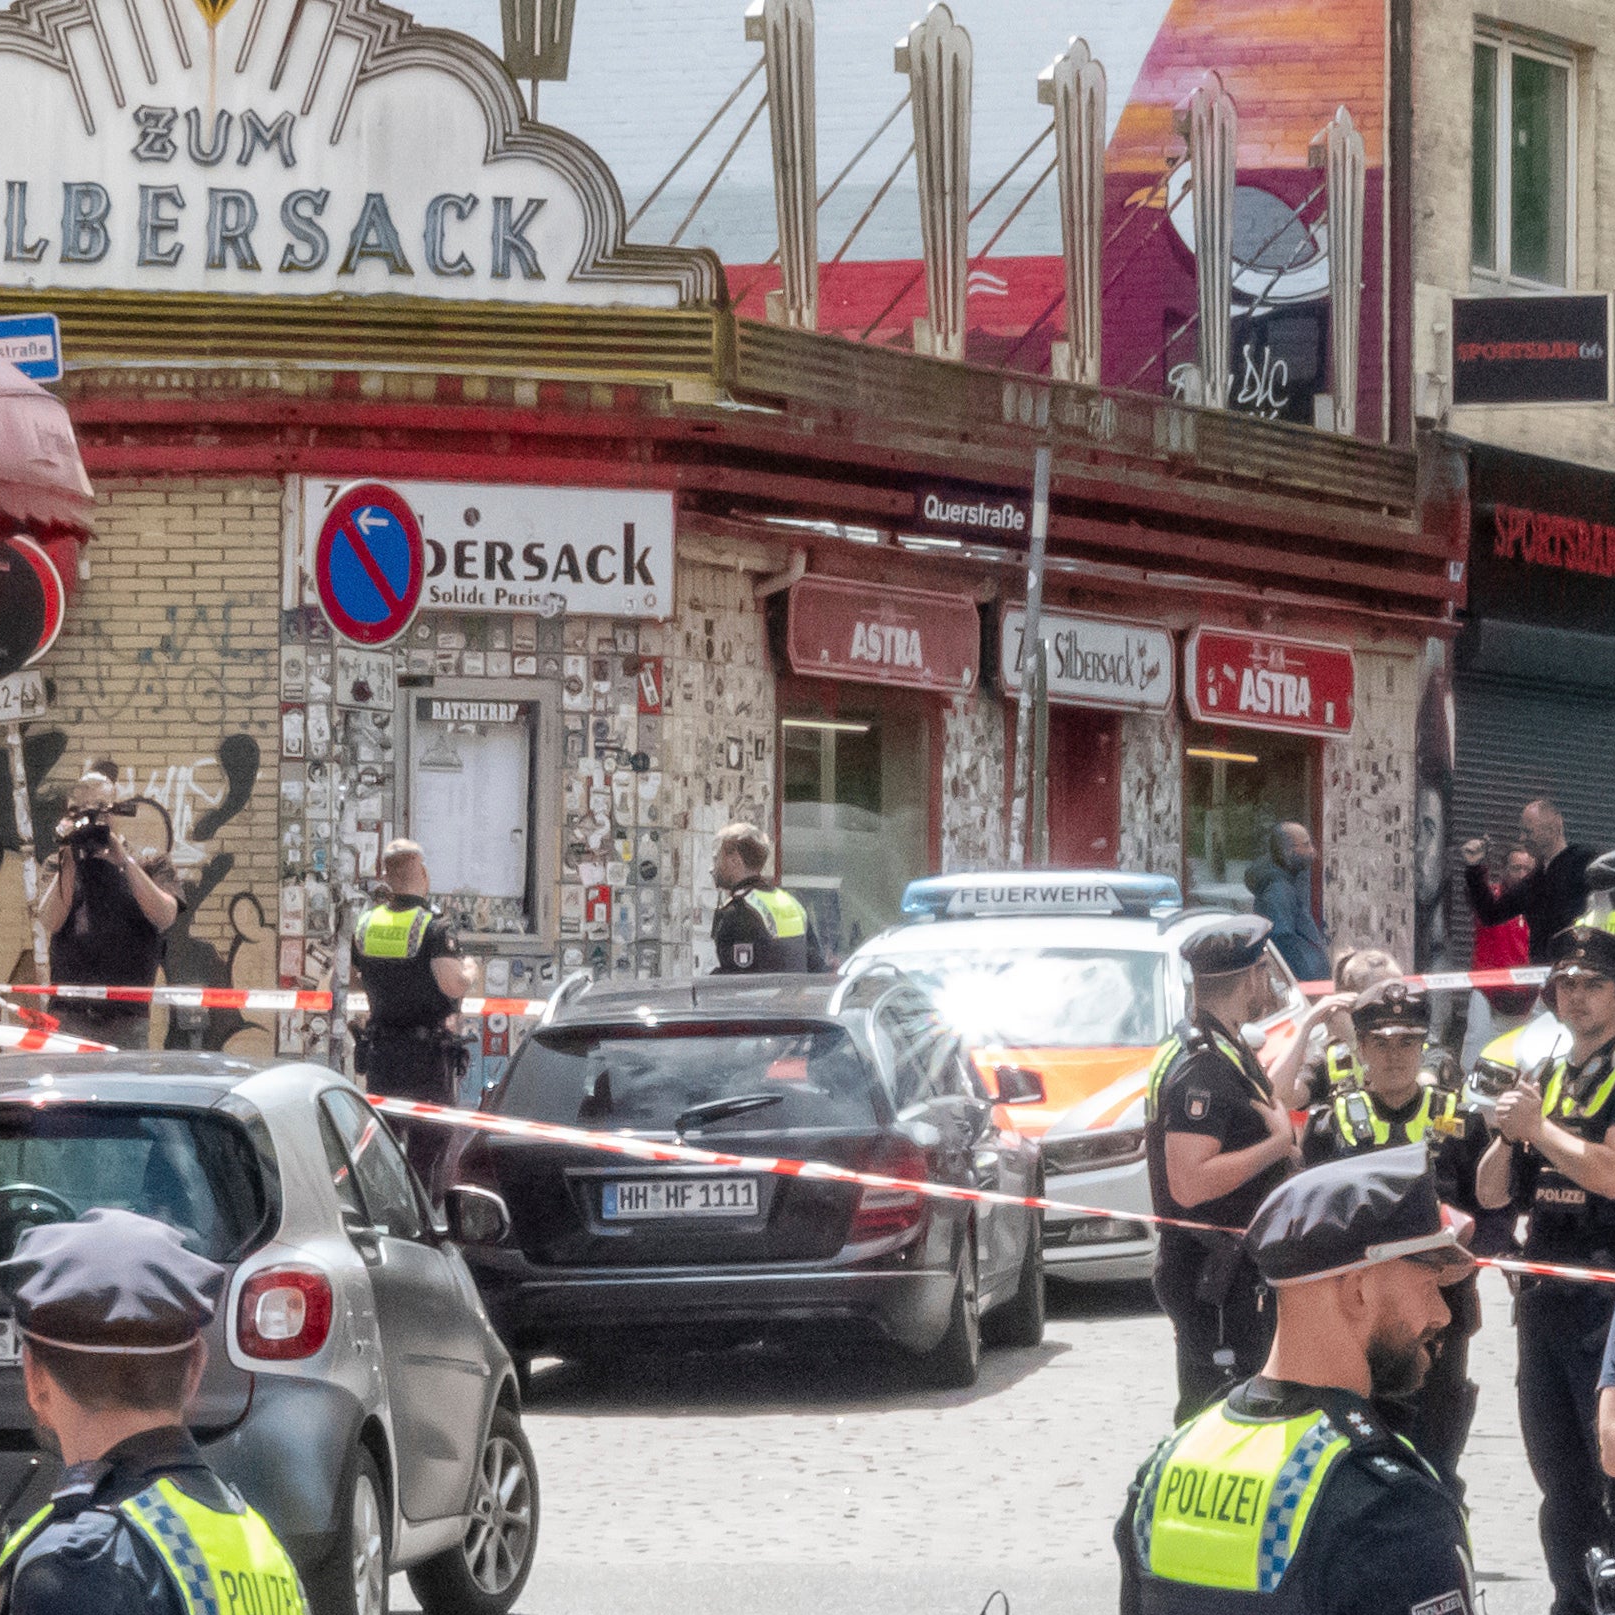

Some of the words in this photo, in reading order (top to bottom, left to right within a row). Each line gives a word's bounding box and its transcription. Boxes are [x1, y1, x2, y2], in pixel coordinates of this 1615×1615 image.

[132, 105, 298, 167] ZUM
[924, 494, 1025, 531] Querstraße
[849, 622, 923, 669] ASTRA
[1239, 667, 1312, 718] ASTRA
[960, 886, 1108, 903] FEUERWEHR
[620, 1186, 648, 1209] HH
[699, 1182, 754, 1207] 1111
[1163, 1466, 1265, 1526] POLIZEI
